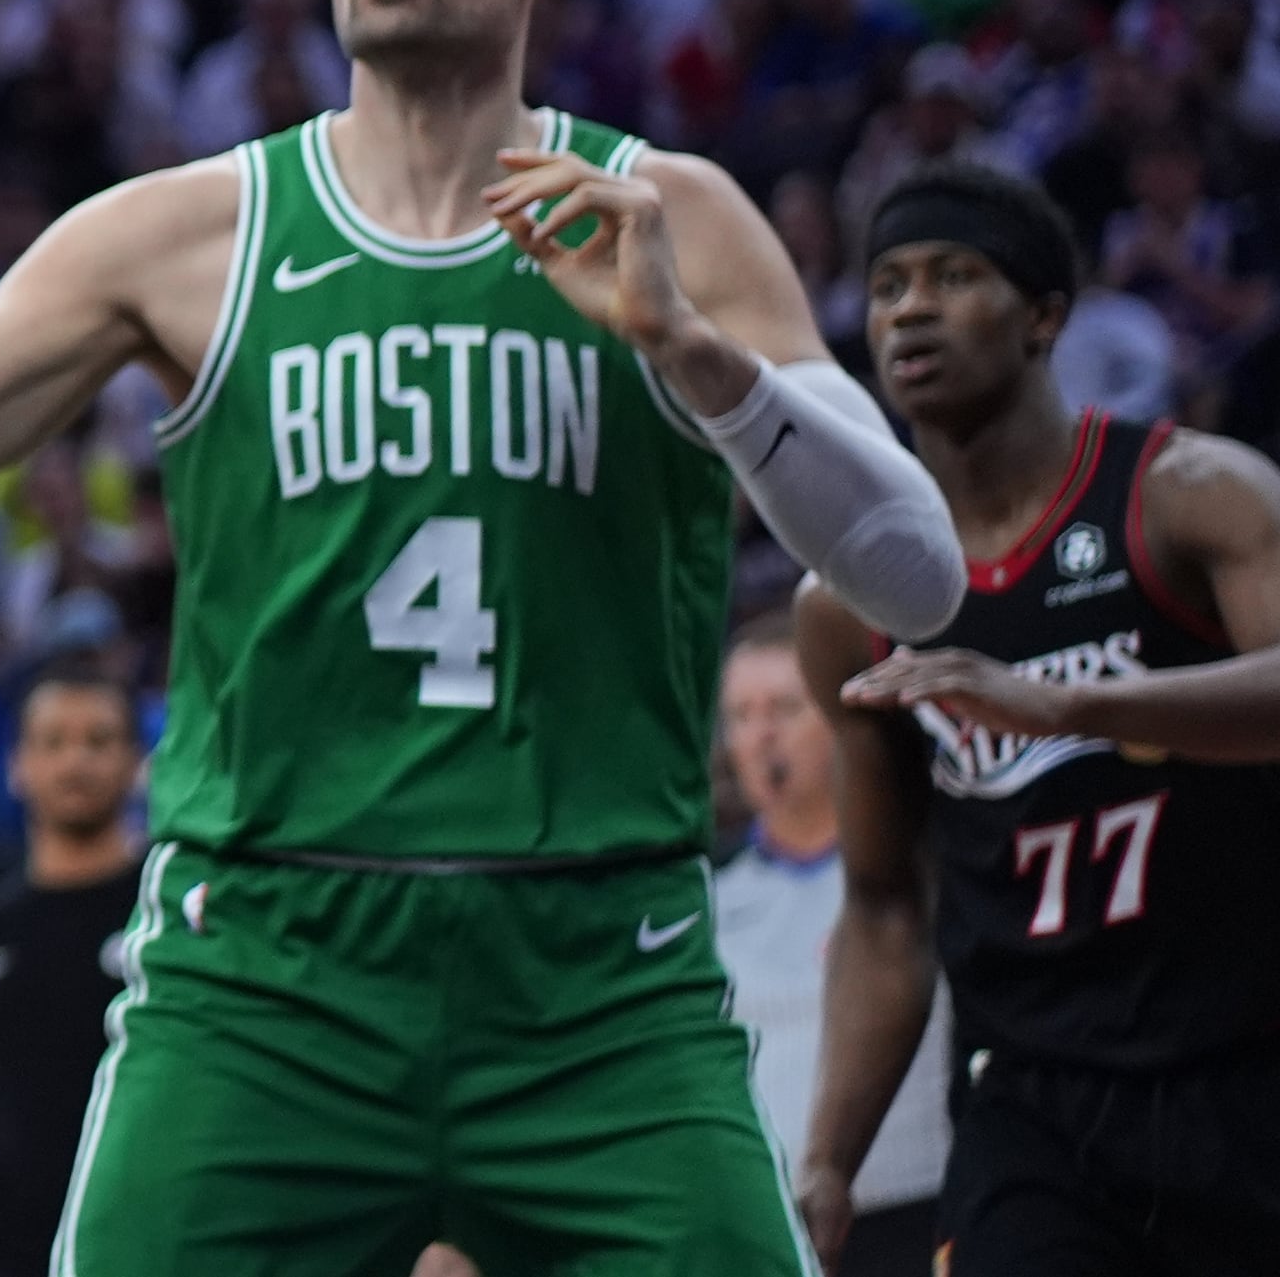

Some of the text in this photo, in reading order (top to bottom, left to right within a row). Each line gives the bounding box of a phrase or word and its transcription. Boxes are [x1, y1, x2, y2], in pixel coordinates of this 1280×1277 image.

[270, 322, 599, 499] BOSTON
[364, 517, 496, 709] 4
[1015, 792, 1170, 937] 77
